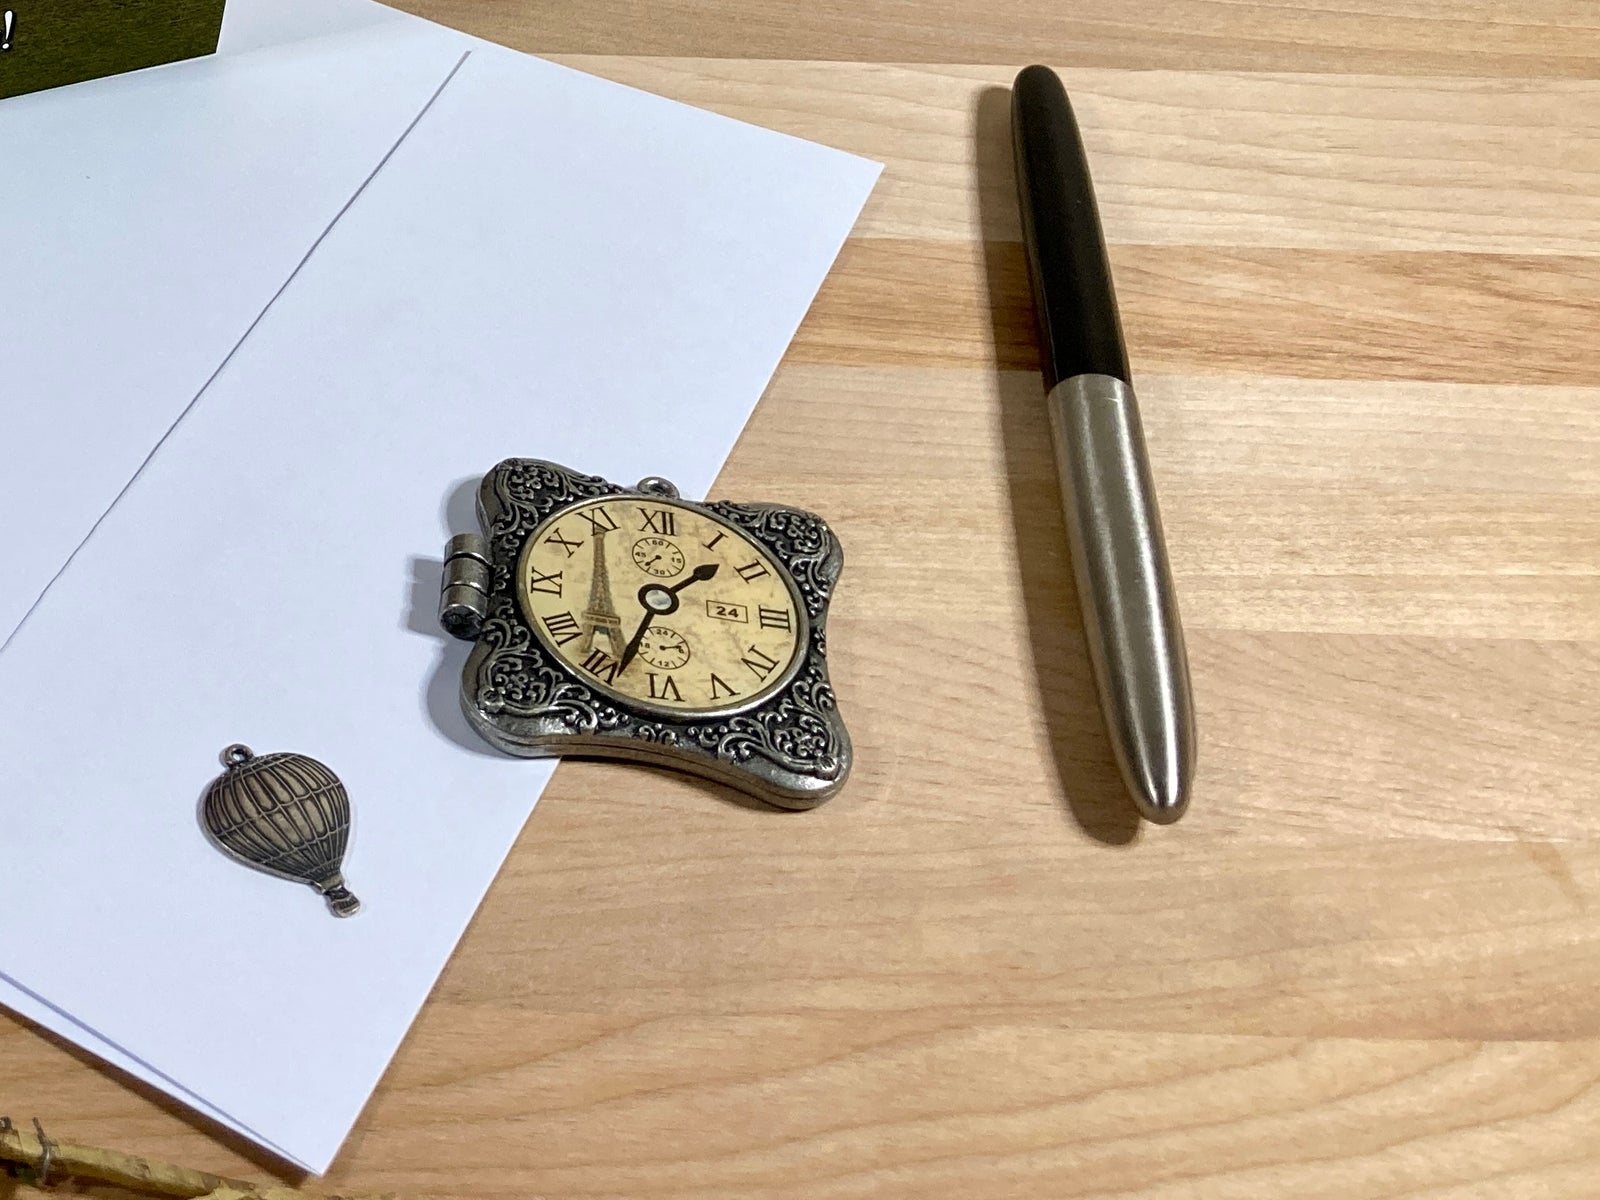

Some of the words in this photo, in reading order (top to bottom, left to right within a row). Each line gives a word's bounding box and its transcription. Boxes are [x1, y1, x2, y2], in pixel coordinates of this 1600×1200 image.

[577, 507, 621, 535] XI
[637, 508, 675, 536] XII
[544, 528, 584, 558] X
[702, 530, 727, 551] I
[531, 566, 563, 598] IX
[734, 558, 771, 584] II
[716, 606, 739, 618] 24
[759, 604, 792, 633] III
[542, 611, 583, 647] VIII
[578, 647, 621, 686] VII
[740, 645, 780, 682] IV
[647, 673, 685, 702] VI
[709, 673, 740, 701] V
